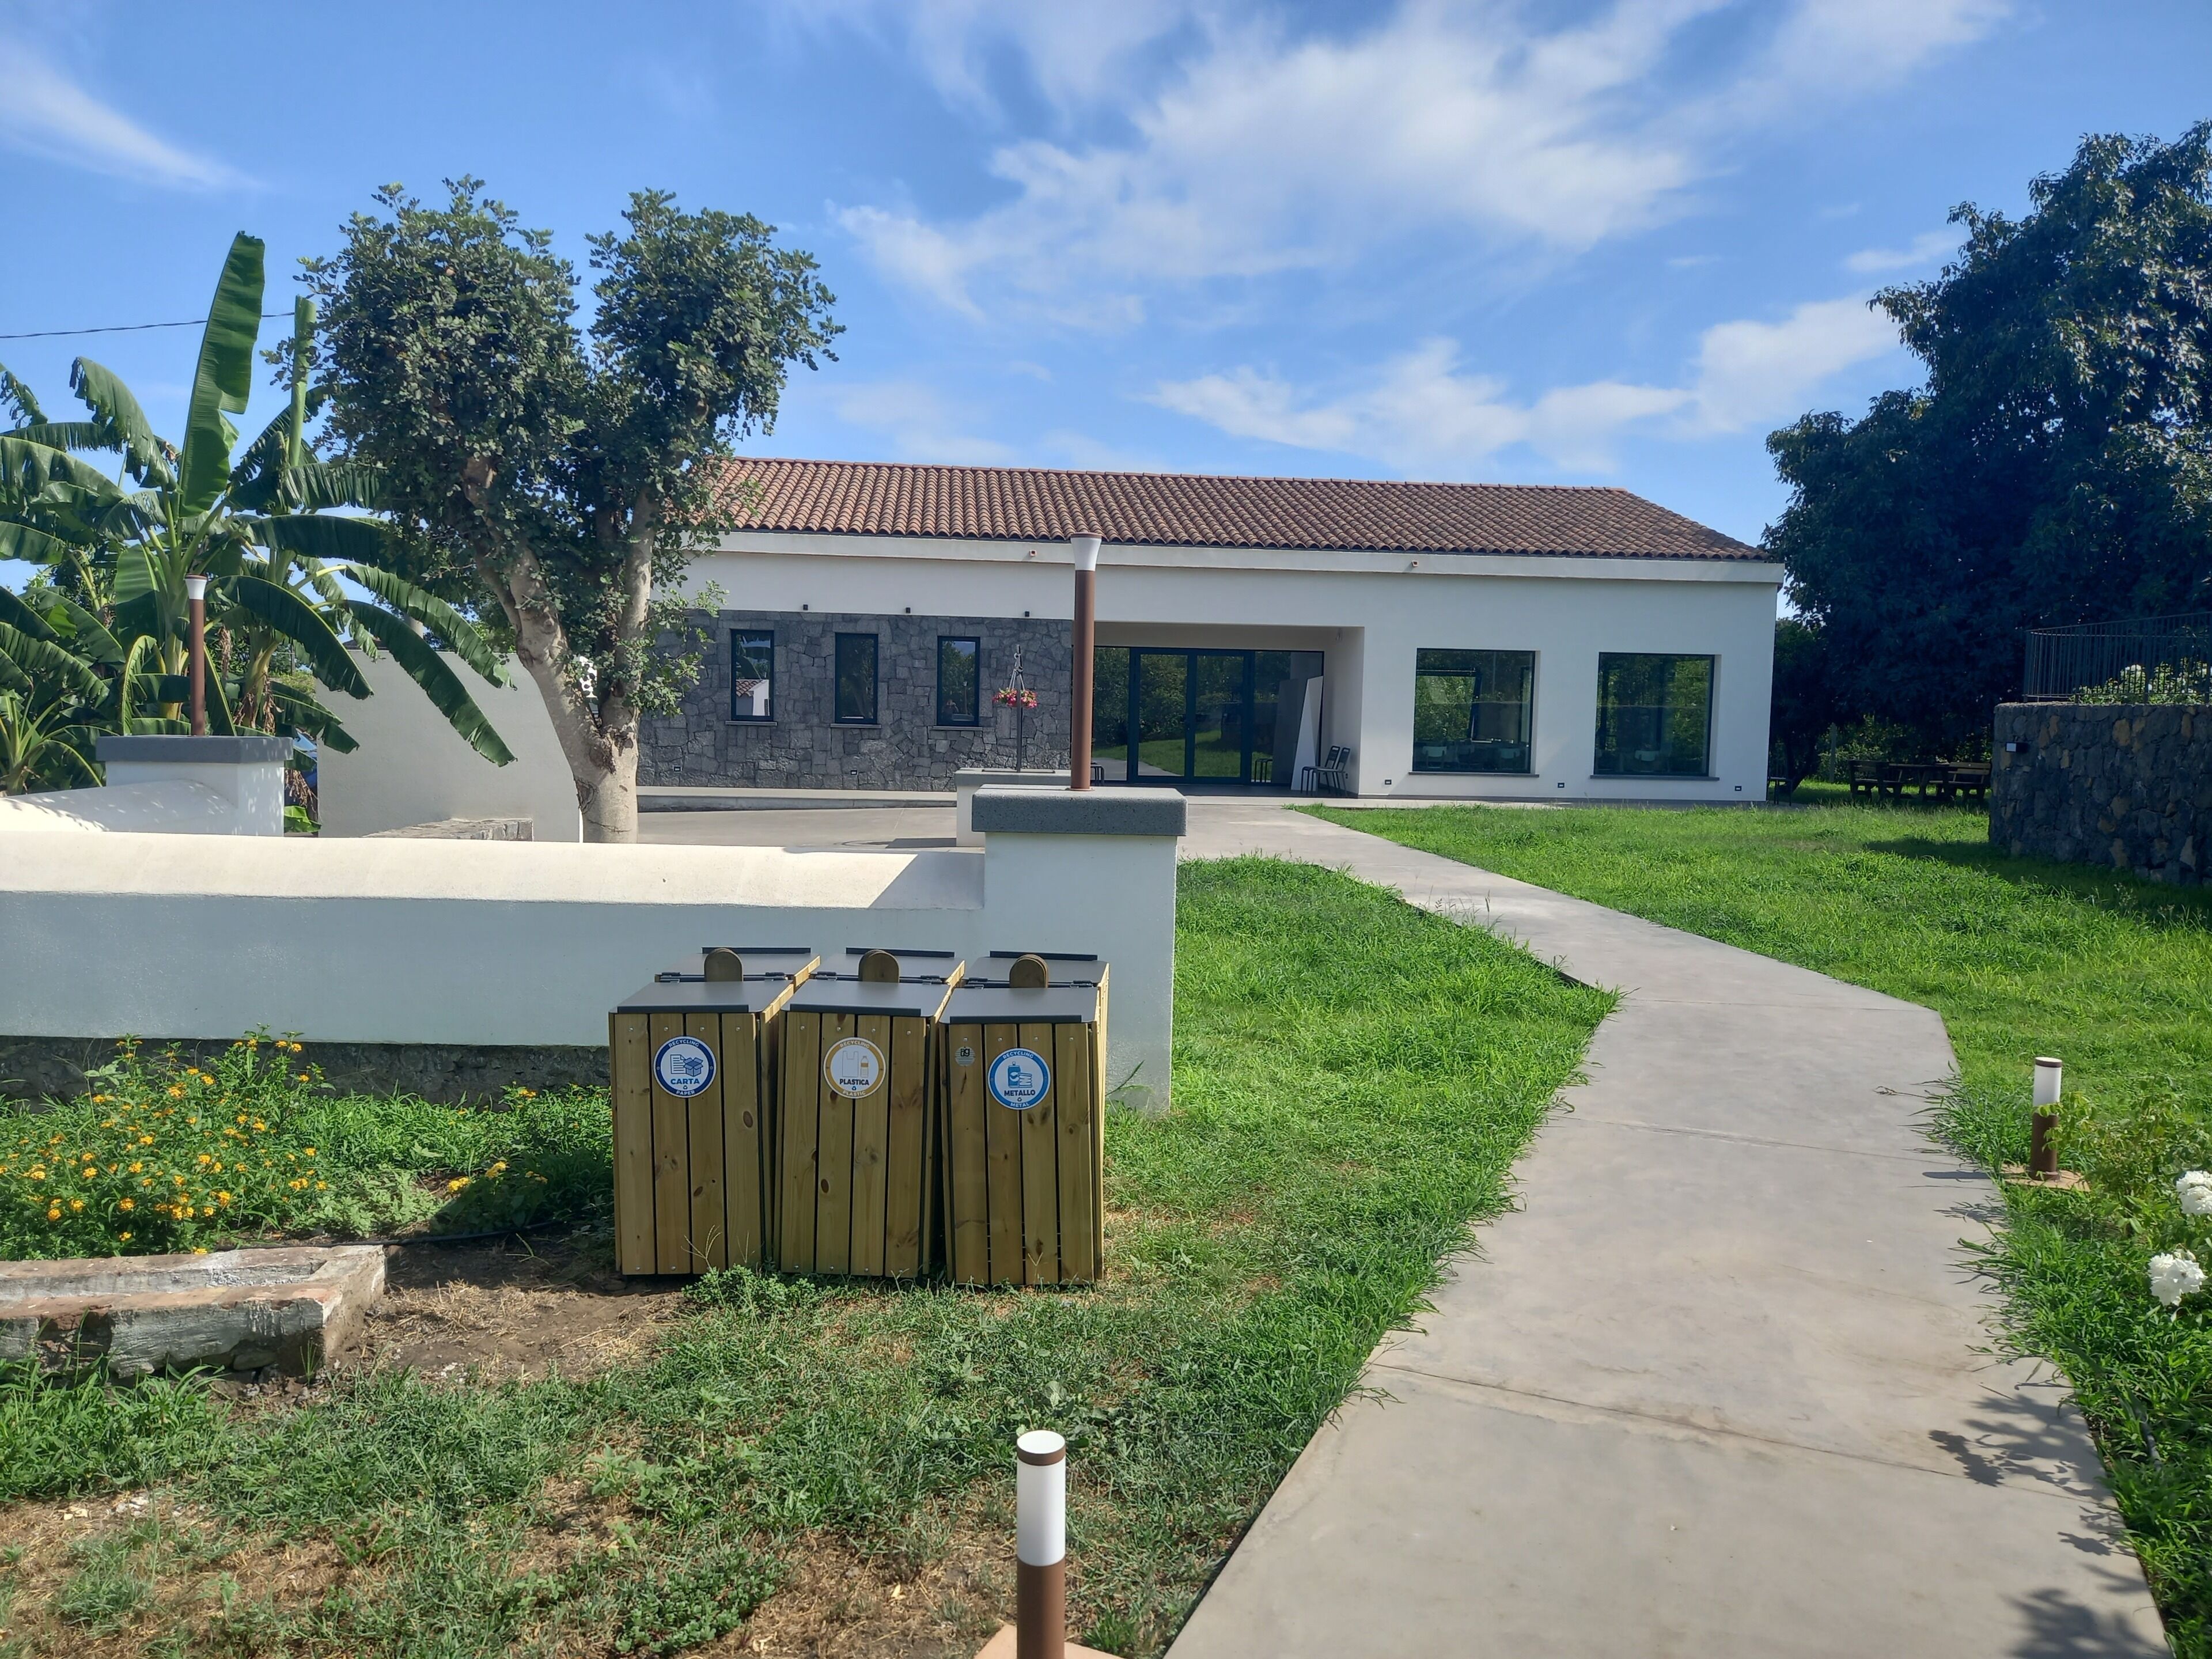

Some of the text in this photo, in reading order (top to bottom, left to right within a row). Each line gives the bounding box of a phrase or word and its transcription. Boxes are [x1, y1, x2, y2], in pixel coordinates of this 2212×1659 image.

[669, 1039, 699, 1048] RECYCLING
[839, 1040, 870, 1048] RECYCLING
[1002, 1051, 1034, 1059] RECYCLING
